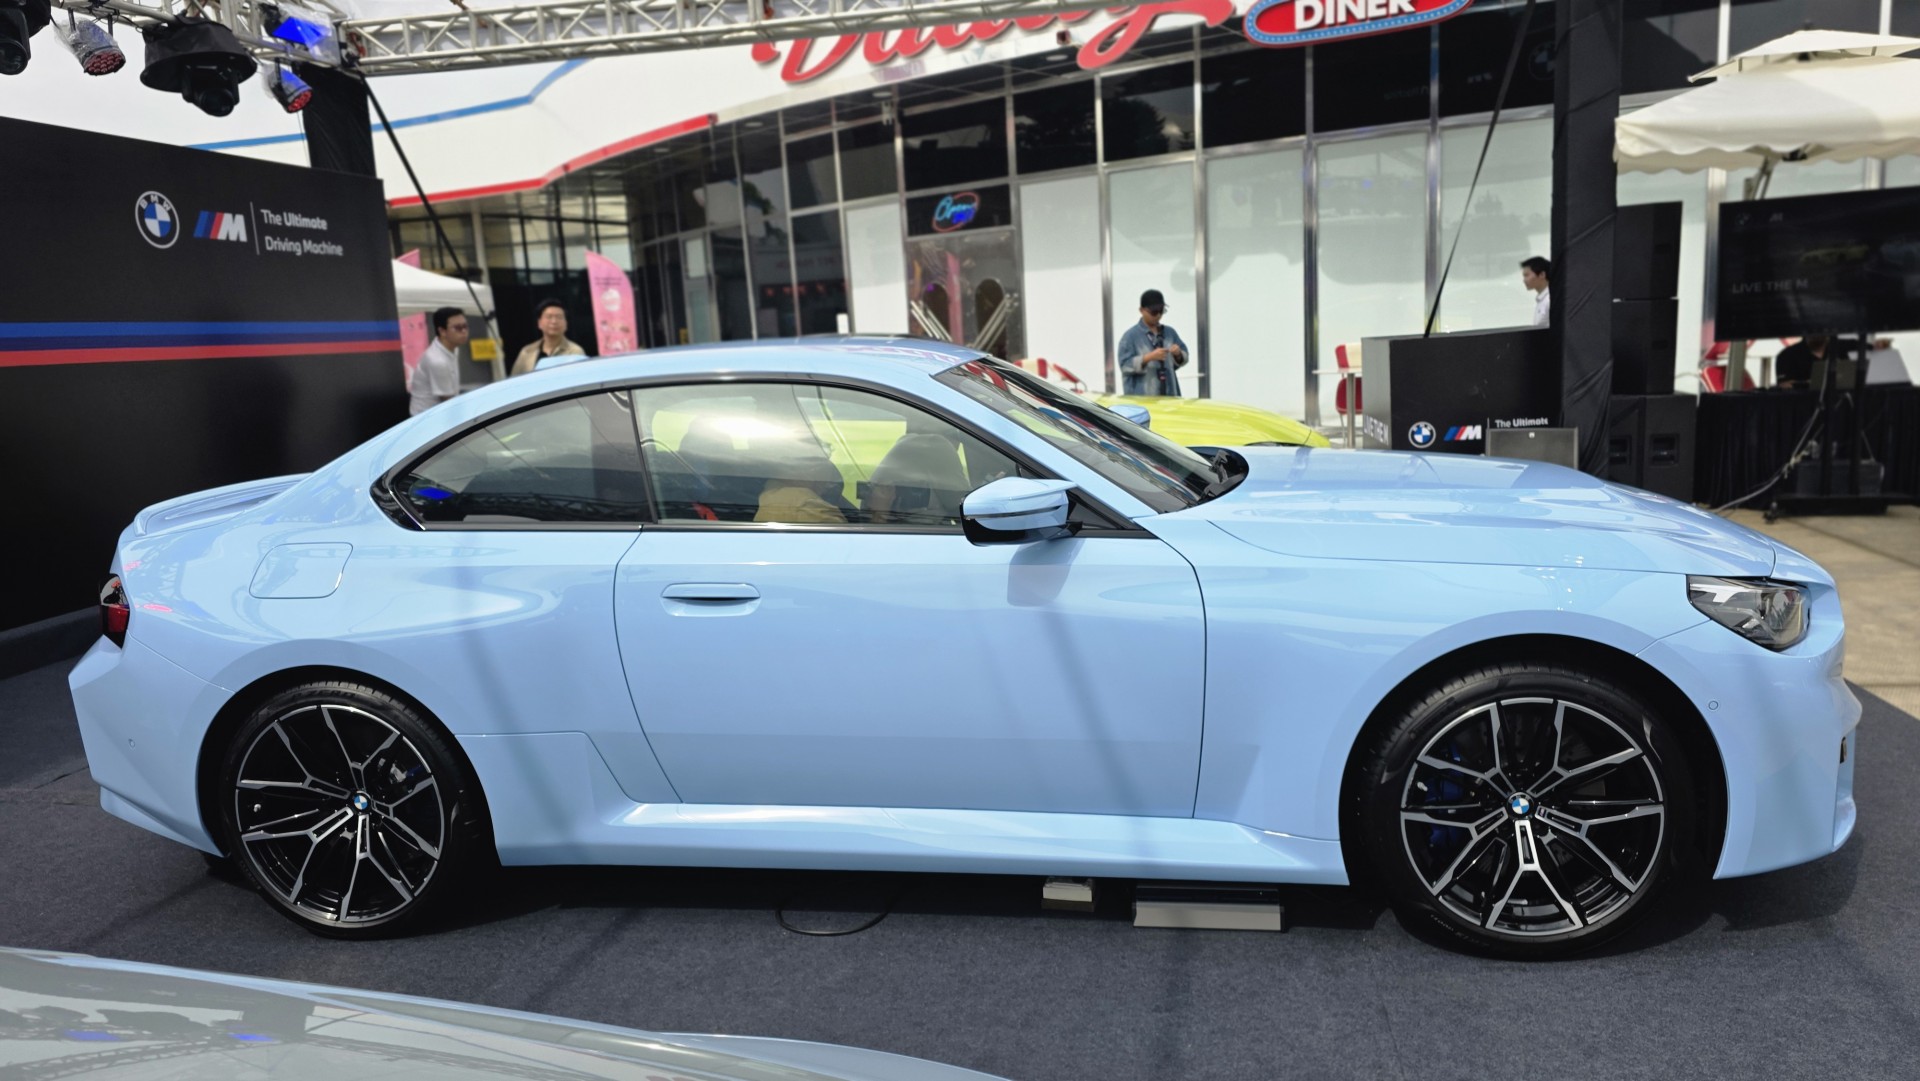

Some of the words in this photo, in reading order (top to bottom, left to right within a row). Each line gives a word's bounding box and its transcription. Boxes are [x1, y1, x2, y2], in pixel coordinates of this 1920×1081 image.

[260, 209, 282, 226] The
[283, 211, 328, 231] Ultimate
[265, 235, 302, 256] Driving
[302, 238, 343, 256] Machine
[1731, 281, 1762, 294] LIVE
[1765, 279, 1792, 291] THE
[1494, 419, 1511, 428] The
